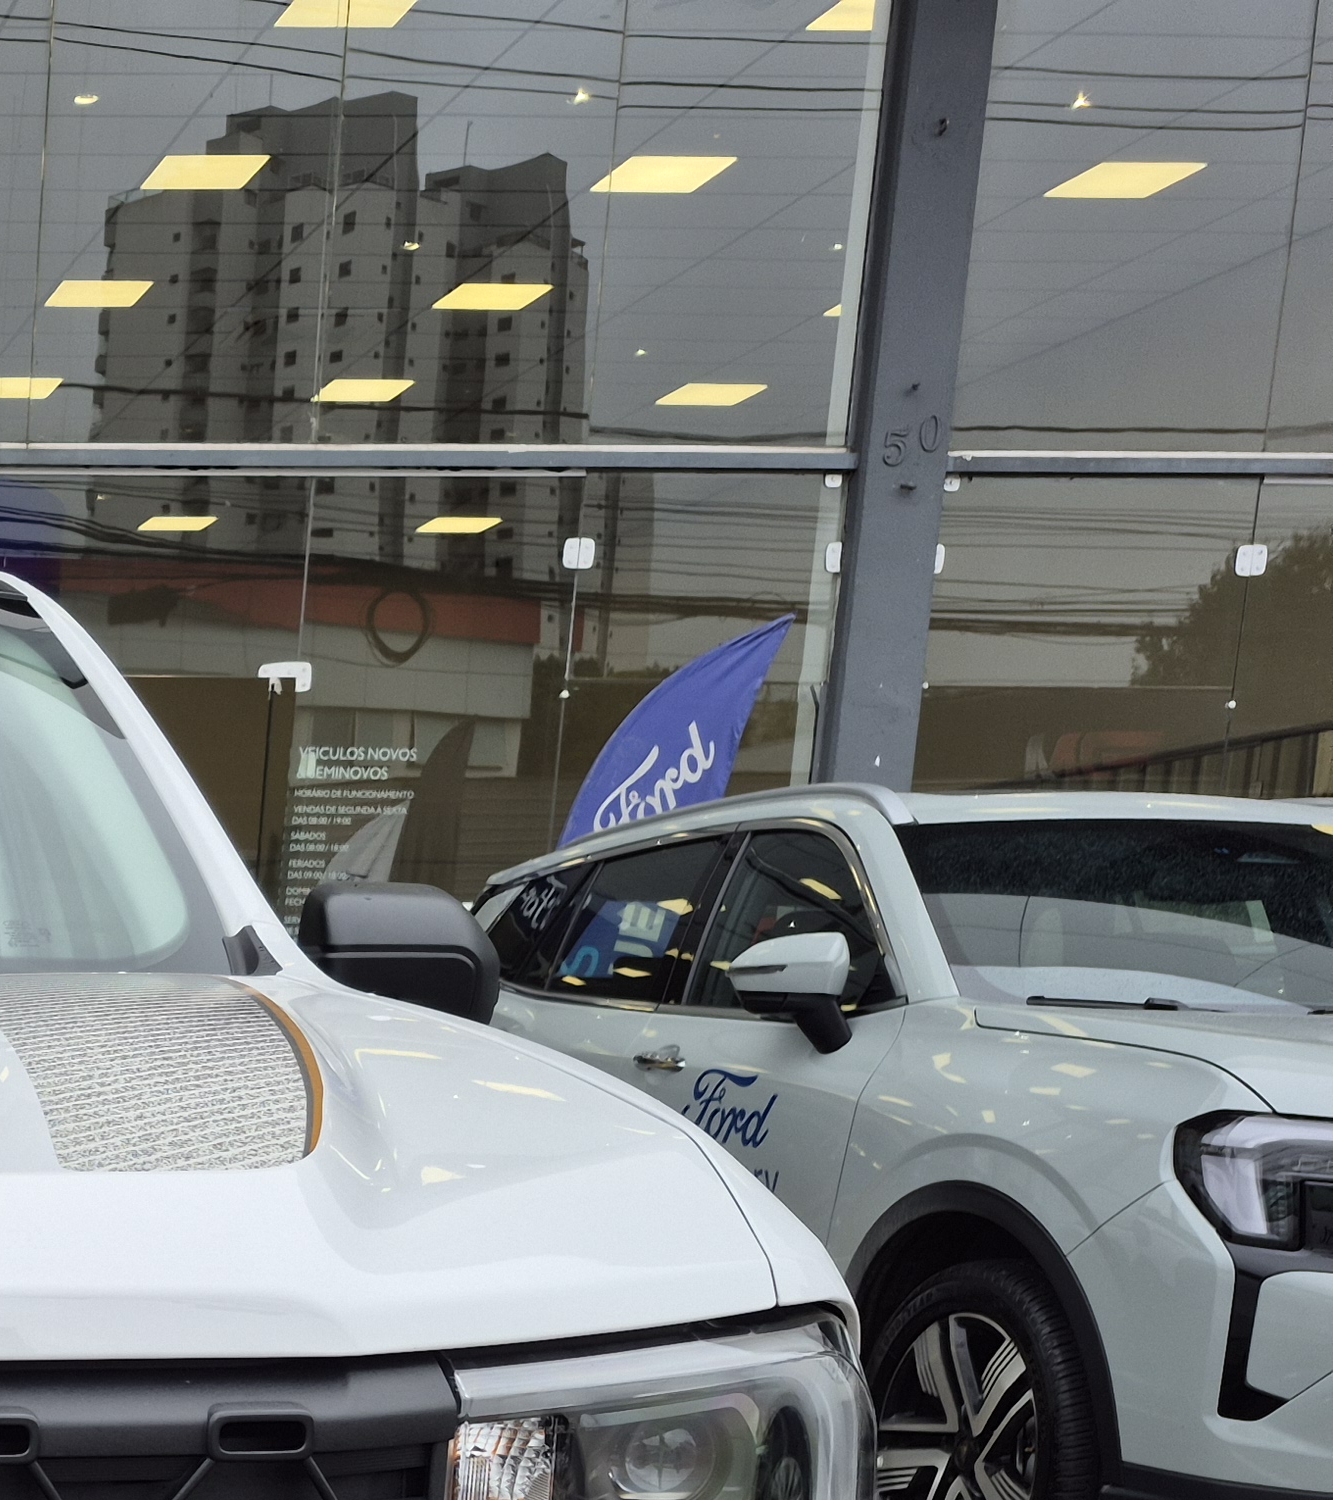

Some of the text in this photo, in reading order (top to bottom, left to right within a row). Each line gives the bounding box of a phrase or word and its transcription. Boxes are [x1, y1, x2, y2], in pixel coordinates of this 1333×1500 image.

[367, 747, 418, 762] NOVOS
[307, 766, 389, 780] EMINOVOS
[681, 1068, 779, 1149] Ford
